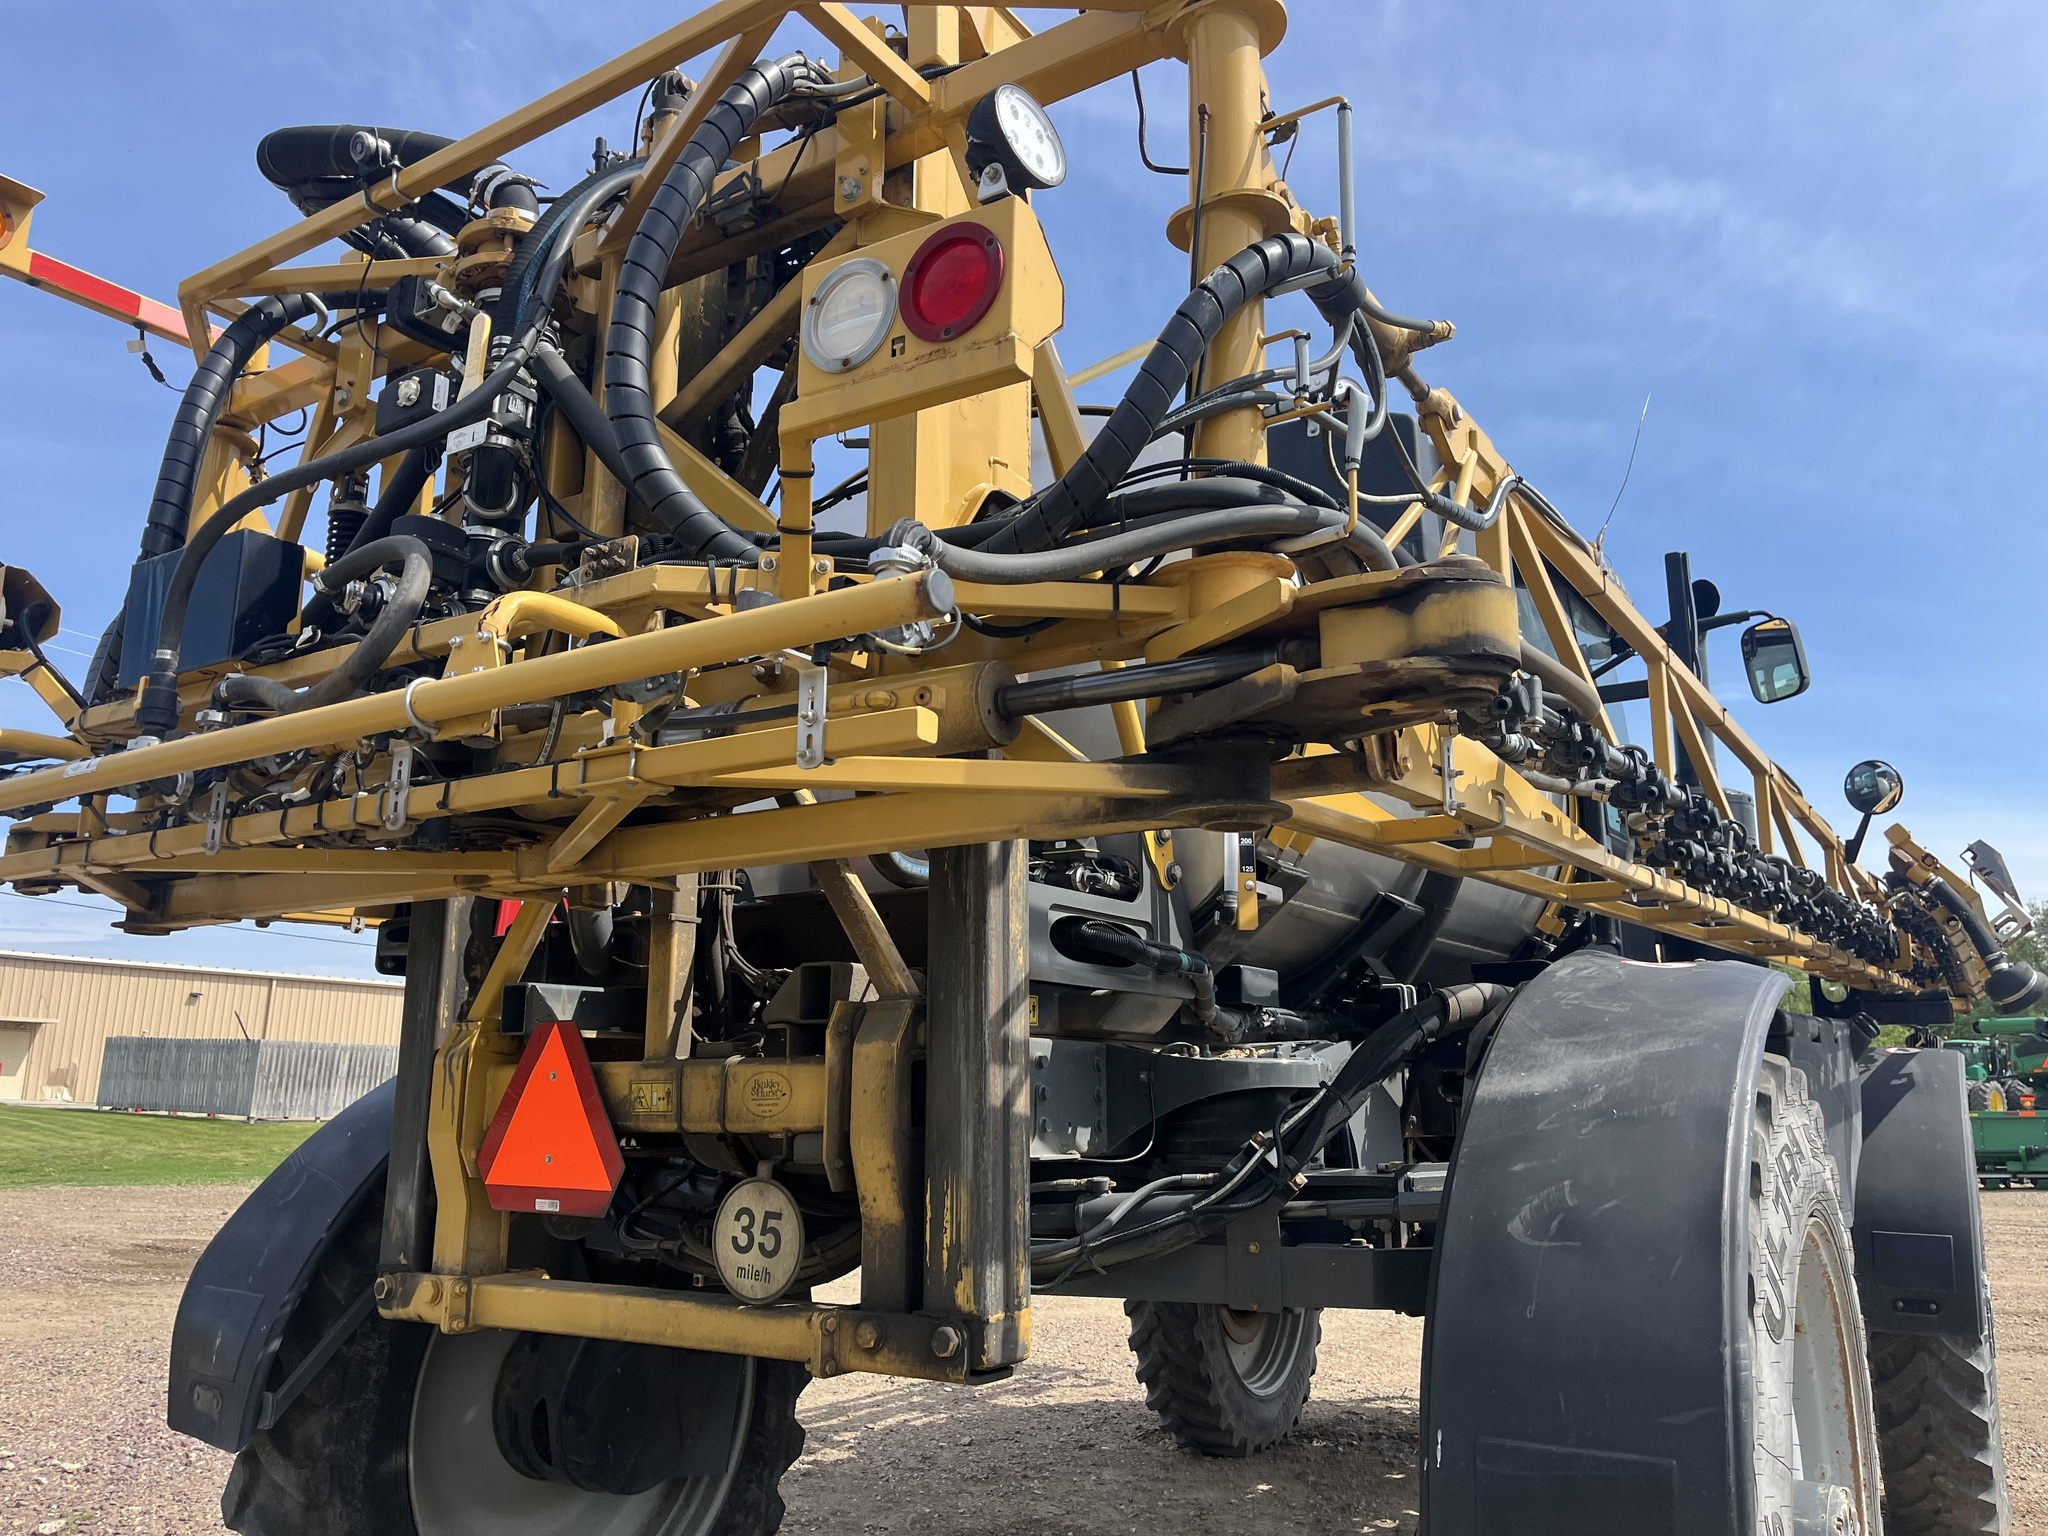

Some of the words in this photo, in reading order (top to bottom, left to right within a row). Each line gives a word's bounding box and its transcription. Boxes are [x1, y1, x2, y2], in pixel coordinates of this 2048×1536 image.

[525, 264, 538, 289] HOSE
[1240, 837, 1253, 845] 200
[1241, 865, 1254, 873] 125
[731, 1206, 783, 1259] 35
[736, 1264, 771, 1284] mile/h
